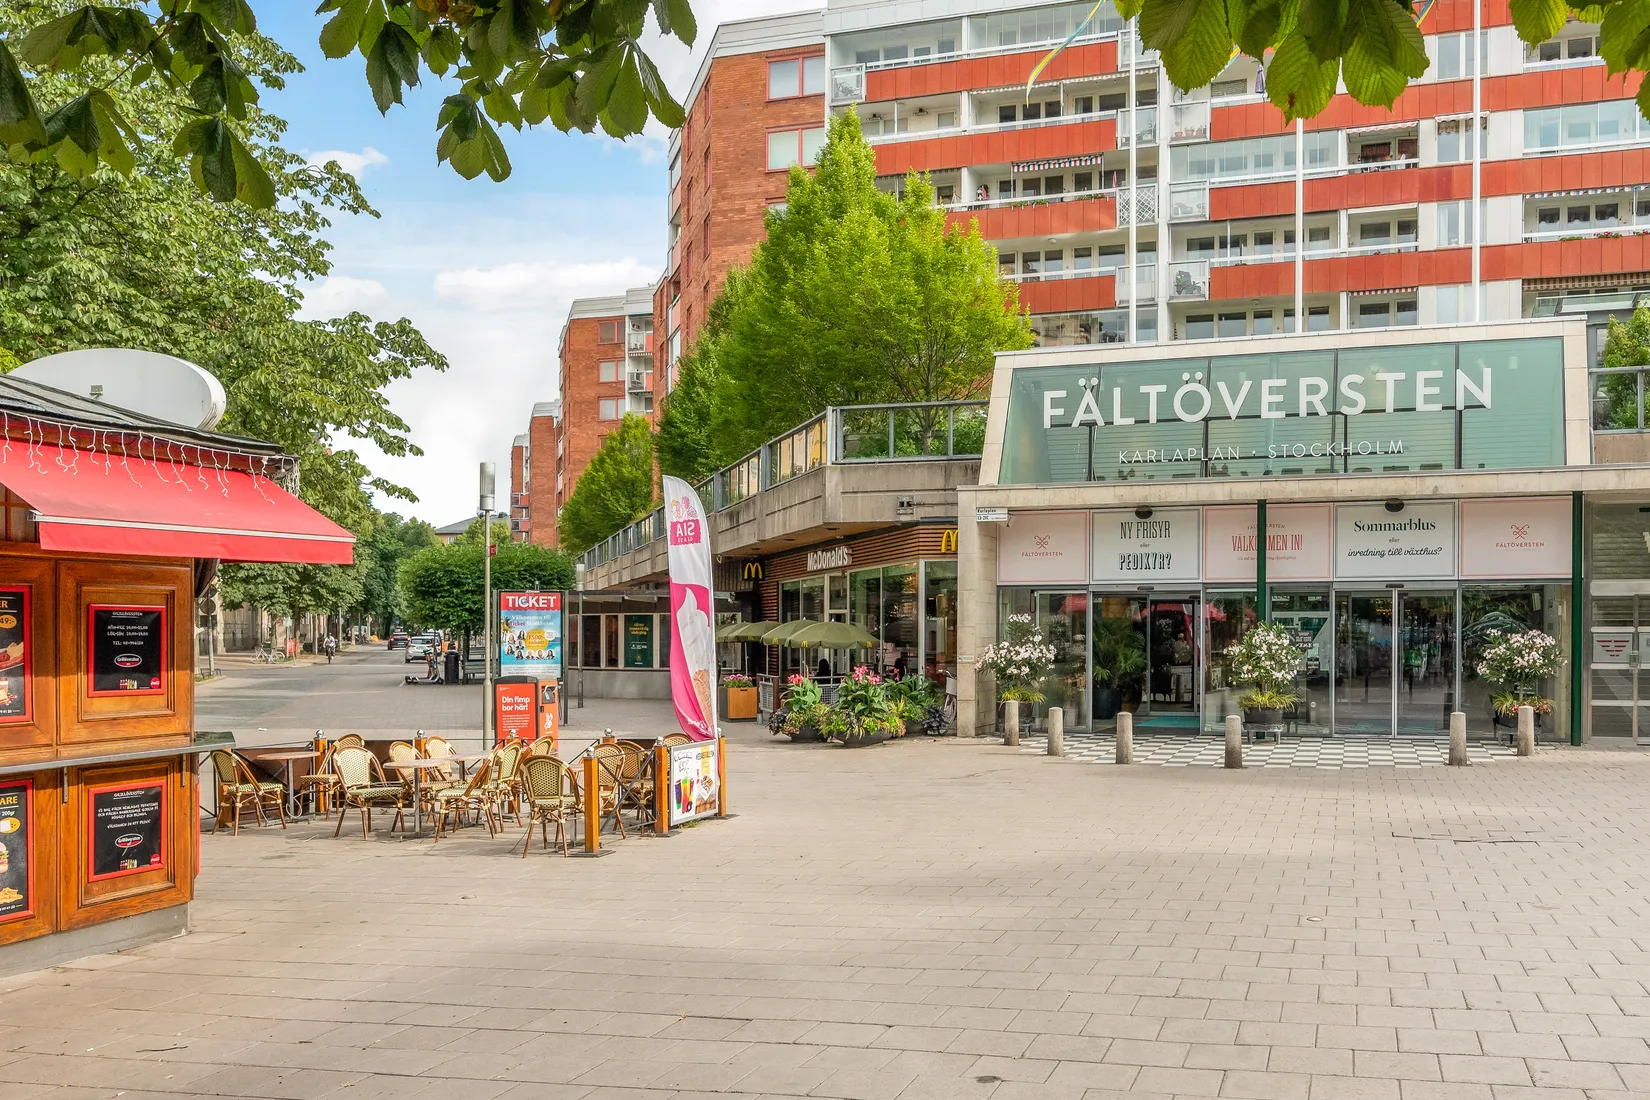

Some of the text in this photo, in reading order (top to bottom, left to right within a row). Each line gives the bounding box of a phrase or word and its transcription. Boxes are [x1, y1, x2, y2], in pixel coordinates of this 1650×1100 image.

[1043, 368, 1492, 429] FÄLTÖVERSTEN
[1119, 440, 1404, 464] KARLAPLAN STOCKHOLM
[1120, 520, 1171, 539] NY FRISYR
[1353, 518, 1436, 532] Sommarblus
[1231, 533, 1303, 551] VÄLKMEN IN!
[807, 545, 848, 571] McDonald's
[1118, 551, 1172, 570] PEDIKYR?
[1347, 546, 1443, 558] inredning till växthus?
[506, 596, 557, 608] TICKET
